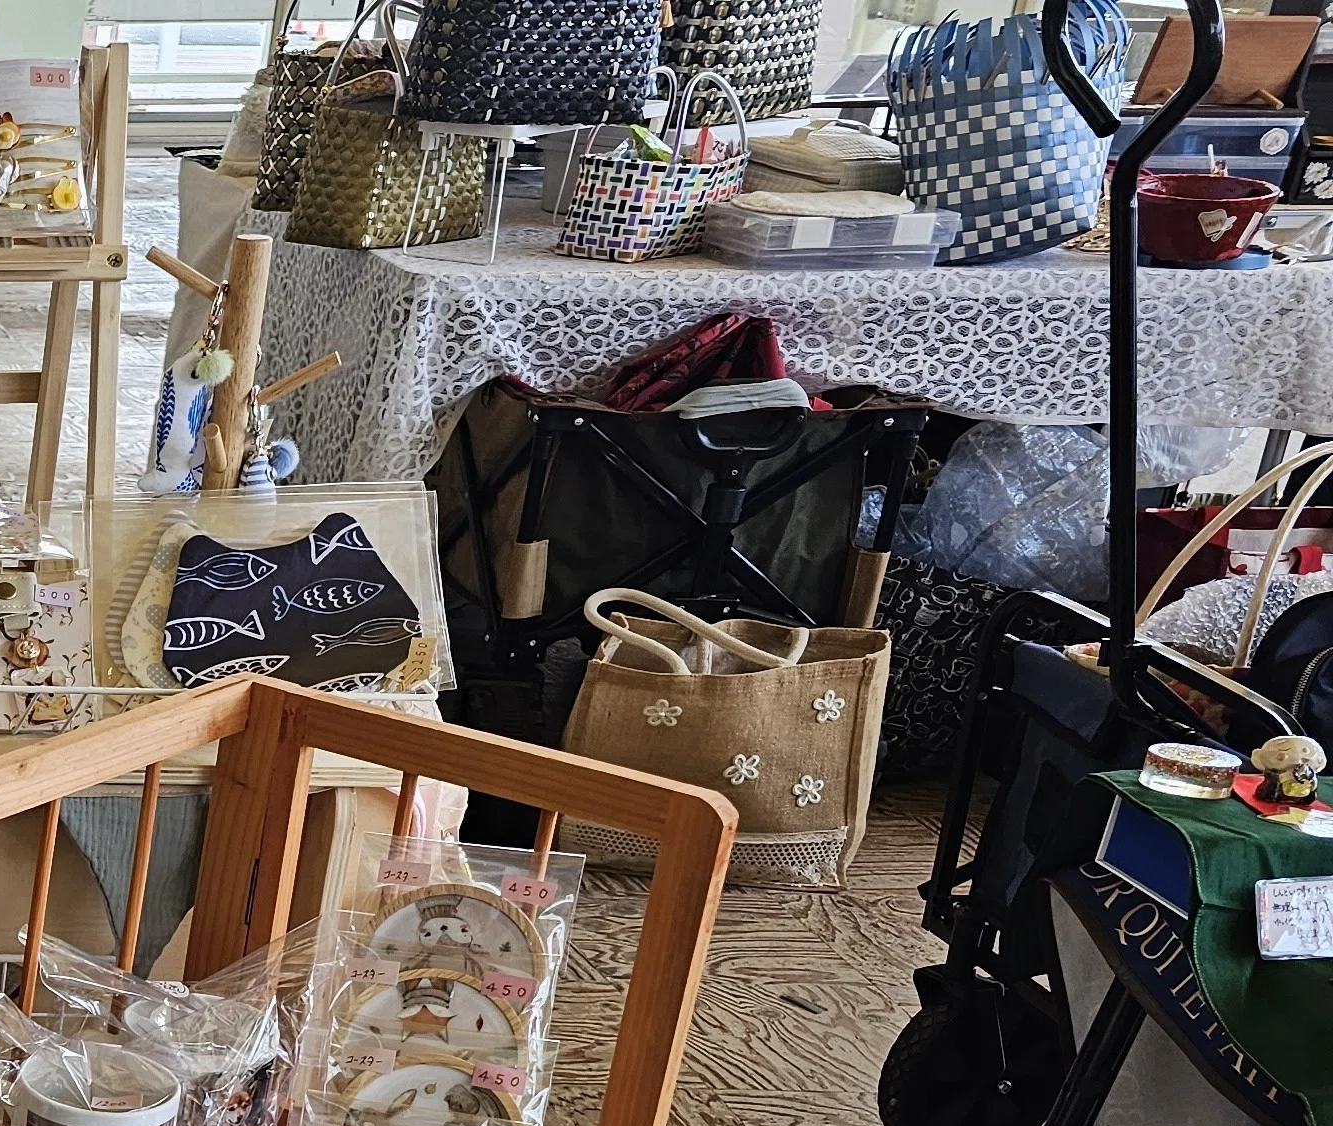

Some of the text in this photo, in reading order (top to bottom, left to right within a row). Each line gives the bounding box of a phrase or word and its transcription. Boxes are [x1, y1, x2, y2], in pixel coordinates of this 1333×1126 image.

[35, 72, 65, 84] 300
[38, 589, 70, 601] 500
[509, 882, 549, 900] 450
[486, 982, 526, 997] 450
[478, 1070, 520, 1087] 450
